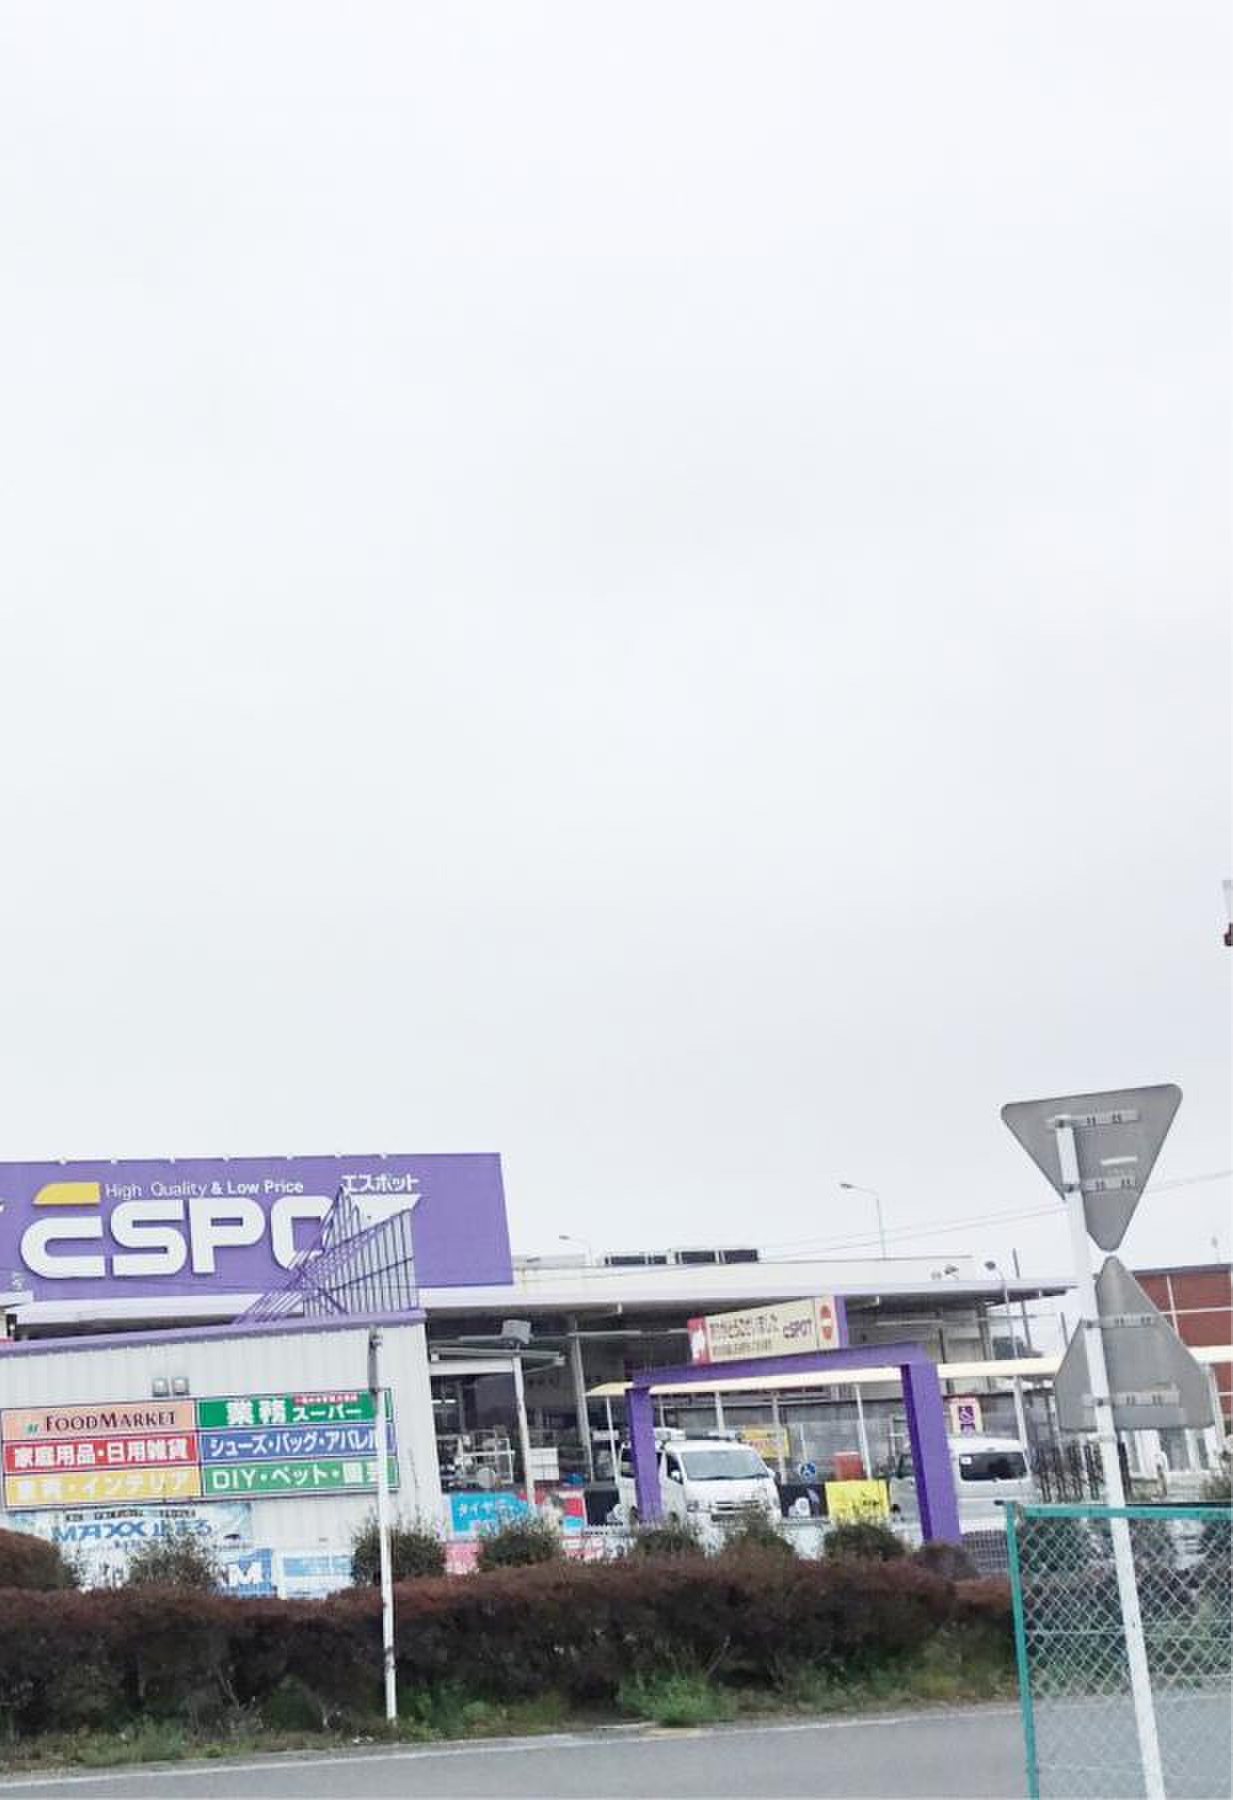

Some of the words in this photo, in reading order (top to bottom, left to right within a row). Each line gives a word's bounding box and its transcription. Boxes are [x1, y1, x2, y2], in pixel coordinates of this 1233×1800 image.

[105, 1184, 142, 1200] High
[151, 1181, 207, 1199] Quality
[210, 1180, 223, 1195] &
[227, 1180, 259, 1195] Low
[264, 1178, 305, 1195] Price
[341, 1173, 421, 1195] エスポット
